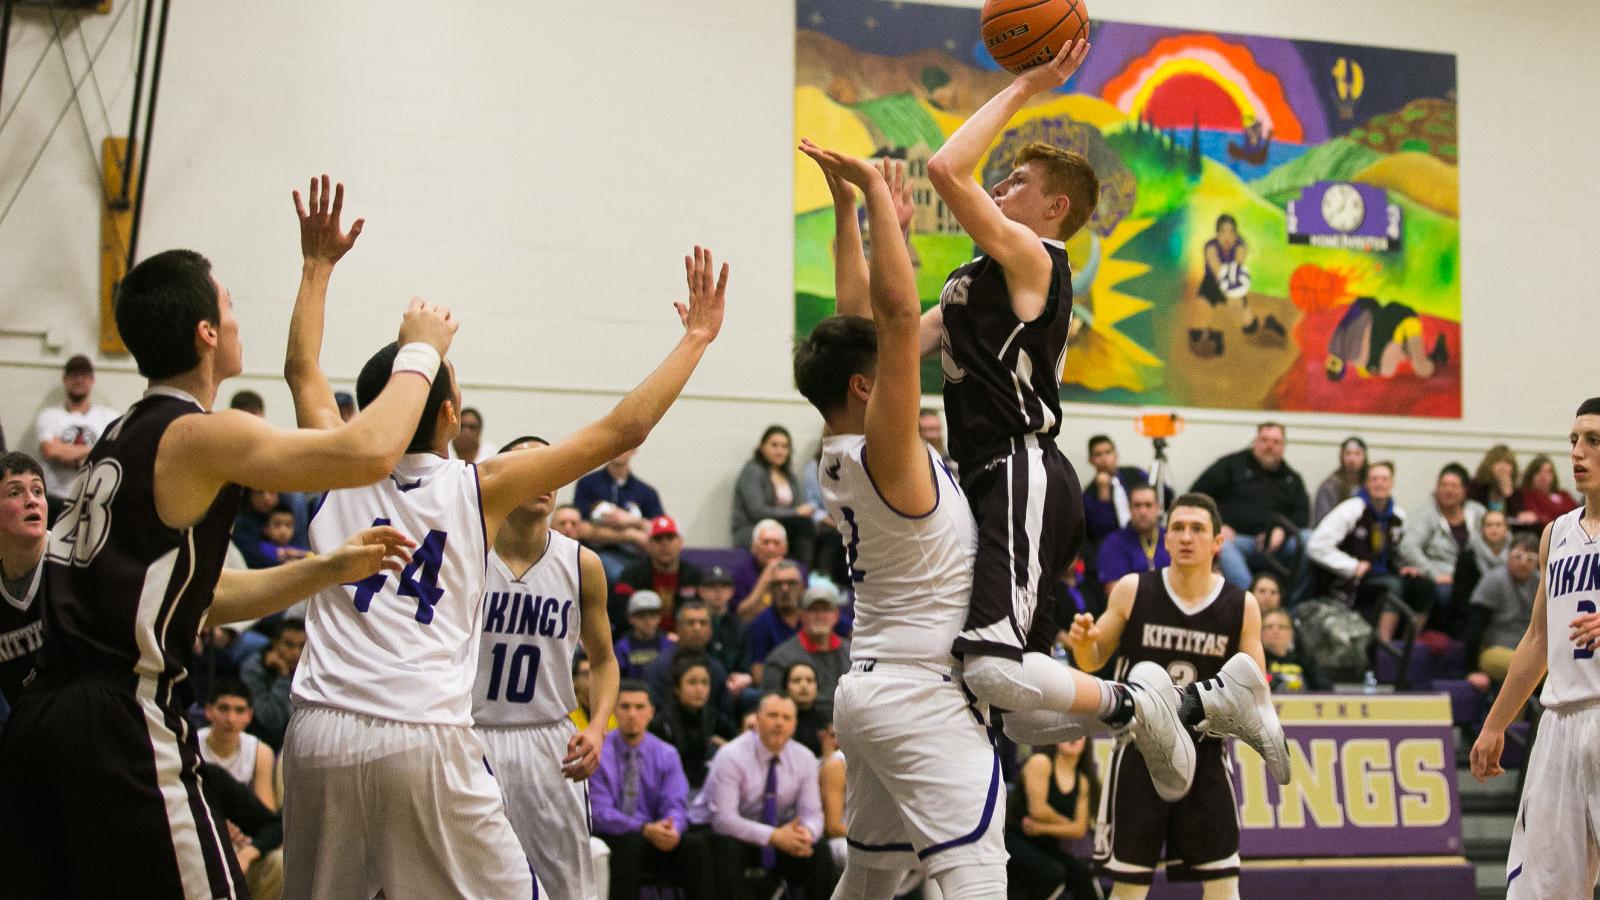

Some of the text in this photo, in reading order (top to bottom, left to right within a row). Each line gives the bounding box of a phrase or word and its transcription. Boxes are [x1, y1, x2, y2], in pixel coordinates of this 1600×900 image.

[983, 23, 1030, 48] ELITE
[1142, 623, 1229, 657] KITTITAS
[486, 642, 541, 703] 10
